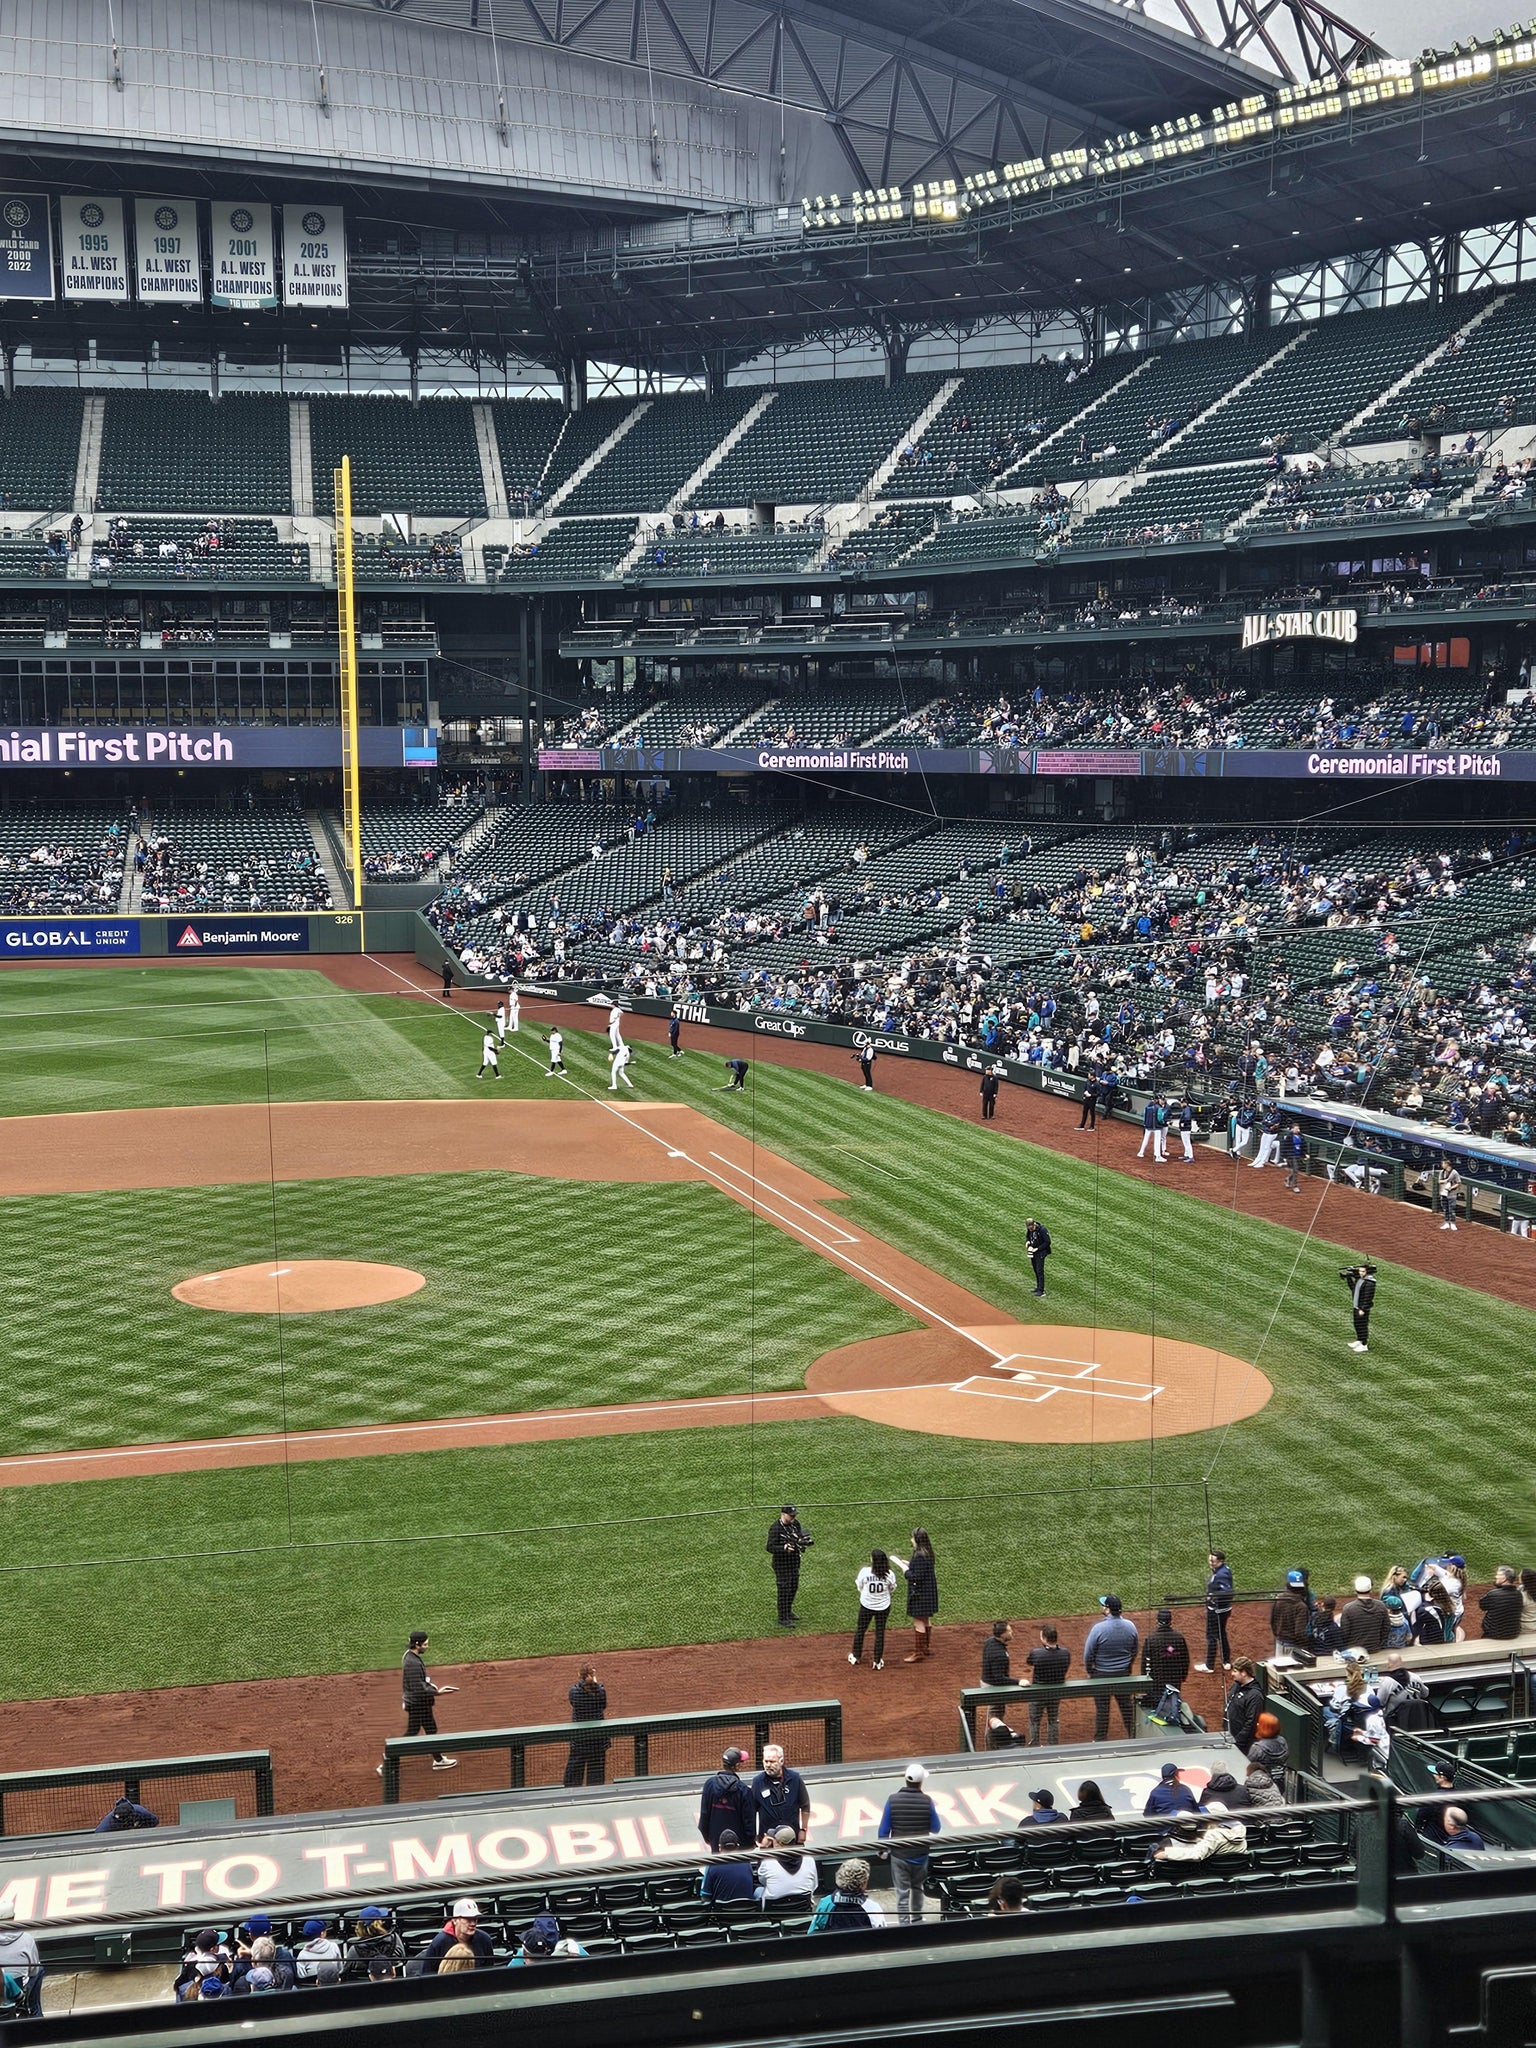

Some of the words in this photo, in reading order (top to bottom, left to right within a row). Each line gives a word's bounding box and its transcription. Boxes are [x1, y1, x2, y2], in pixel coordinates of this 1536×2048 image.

[19, 241, 40, 250] CARD
[79, 234, 109, 252] 1995
[153, 237, 181, 254] 1997
[229, 239, 257, 256] 2001
[7, 251, 31, 261] 2000
[301, 243, 329, 259] 2025
[8, 261, 31, 272] 2022
[71, 256, 89, 270] A.L.
[90, 256, 118, 271] WEST
[146, 259, 163, 273] A.L.
[165, 259, 191, 274] WEST
[221, 261, 238, 275] A.L.
[240, 261, 266, 276] WEST
[294, 264, 310, 277] A.L.
[312, 264, 336, 278] WEST
[66, 275, 125, 291] CHAMPIONS
[140, 277, 198, 293] CHAMPIONS
[216, 280, 273, 295] CHAMPIONS
[289, 282, 343, 297] CHAMPIONS
[242, 299, 260, 309] WINS
[1316, 609, 1358, 643] CLUB
[58, 732, 140, 761] First
[146, 731, 233, 761] Pitch
[758, 752, 848, 768] Ceremonial
[850, 752, 877, 769] First
[879, 752, 909, 769] Pitch
[1308, 753, 1408, 774] Ceremonial
[1411, 754, 1456, 775] First
[1459, 754, 1500, 775] Pitch
[335, 915, 353, 924] 326
[6, 931, 91, 946] GLOBAL
[95, 930, 129, 938] CREDIT
[202, 931, 258, 945] Benjamin
[260, 931, 300, 942] Moore
[673, 1003, 710, 1024] STIHL
[754, 1016, 783, 1032] Great
[782, 1020, 806, 1037] Clips
[868, 1037, 909, 1052] LEXUS
[869, 1582, 884, 1594] 00
[140, 1855, 282, 1908] TO
[301, 1815, 704, 1890] T-MOBIL
